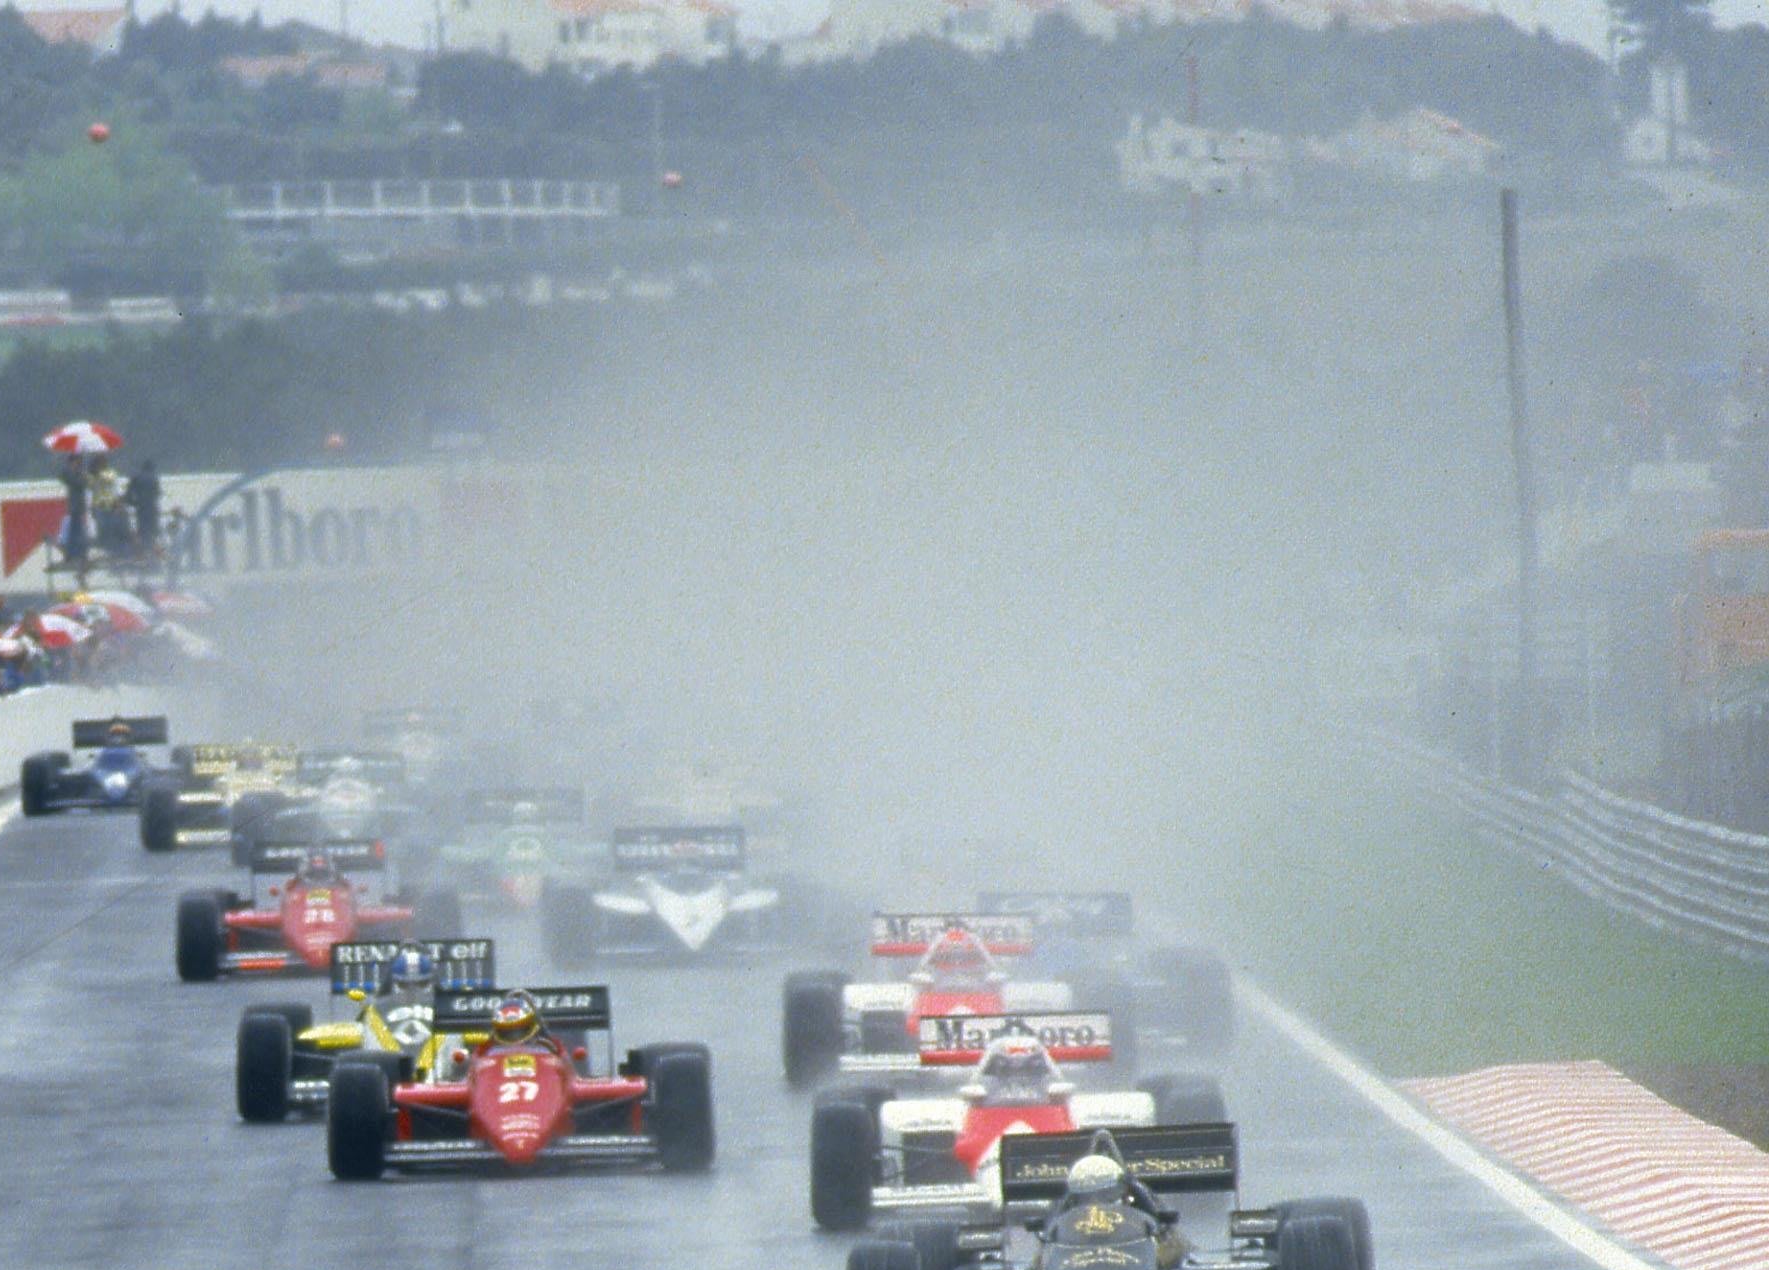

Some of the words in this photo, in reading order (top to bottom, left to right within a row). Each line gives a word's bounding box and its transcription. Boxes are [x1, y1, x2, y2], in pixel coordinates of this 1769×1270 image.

[336, 944, 445, 963] RENT
[453, 994, 592, 1011] GOOYEAR
[498, 1080, 539, 1104] 27
